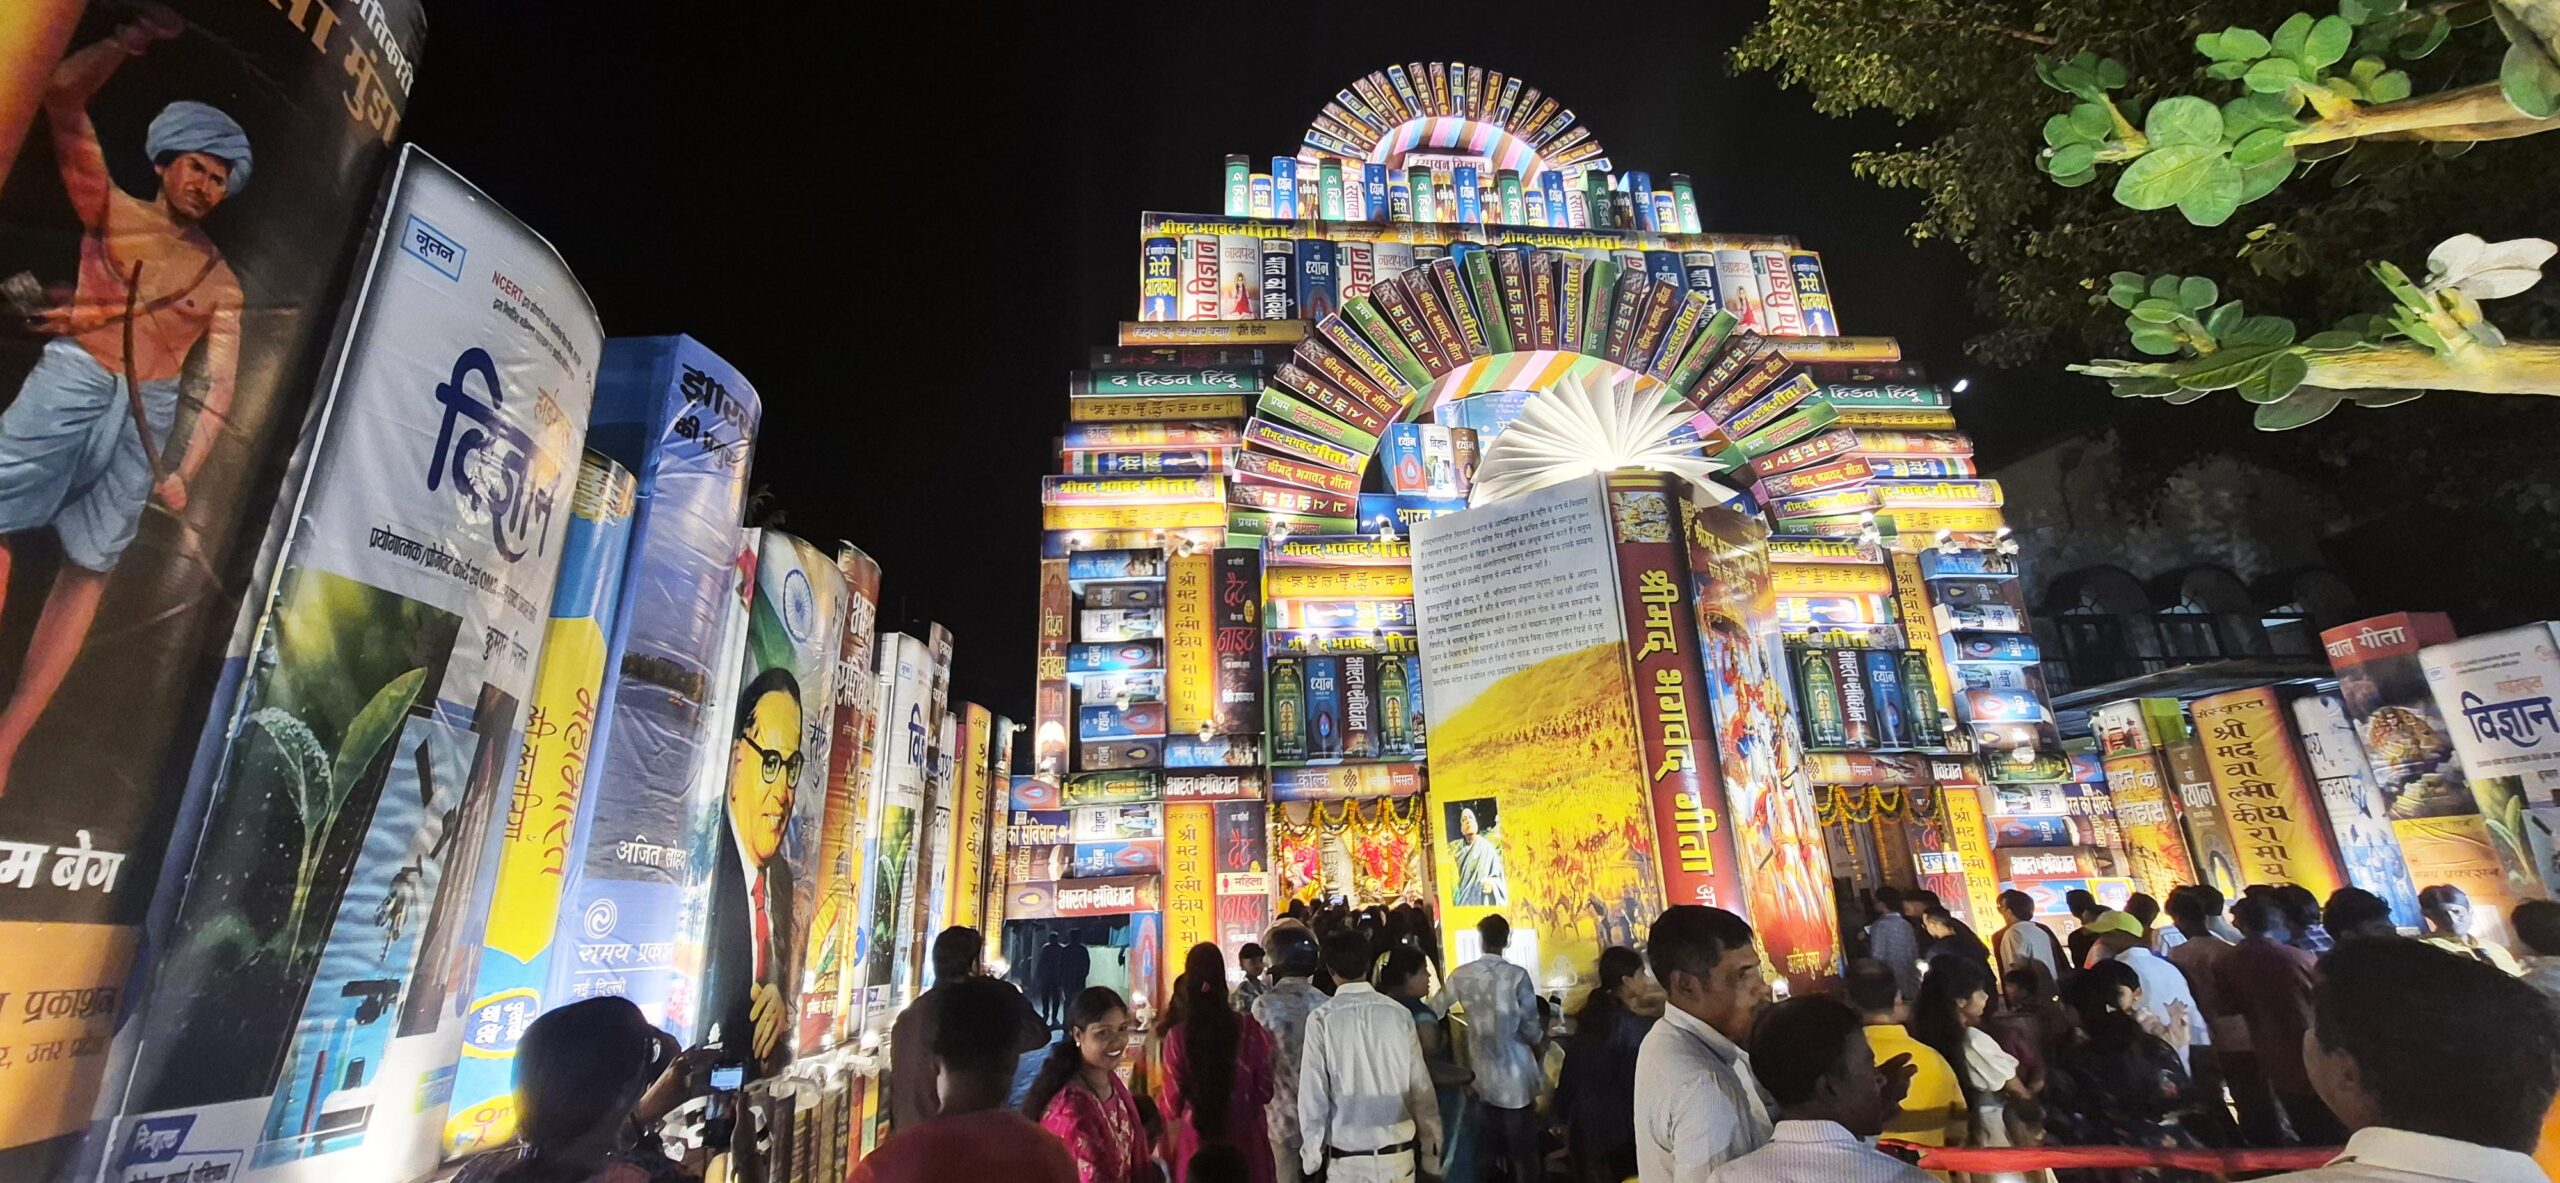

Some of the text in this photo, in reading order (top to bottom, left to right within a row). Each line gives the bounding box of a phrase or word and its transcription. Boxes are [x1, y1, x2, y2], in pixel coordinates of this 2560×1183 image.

[416, 228, 455, 263] नूतन
[1148, 255, 1172, 277] मेरी
[1304, 260, 1330, 276] ध्यान
[492, 270, 524, 303] NCERT
[1111, 374, 1129, 388] द
[1137, 371, 1195, 387] हिडन
[2357, 626, 2407, 650] गीता
[1310, 677, 1334, 691] ध्यान
[2196, 699, 2265, 719] संस्कृत
[2460, 690, 2560, 748] विज्ञान
[1167, 773, 1240, 797] भारत संविधान
[2179, 781, 2217, 809] ध्यान
[1674, 790, 1719, 876] गीता
[616, 834, 662, 867] अजित
[1234, 874, 1263, 887] महिला
[1058, 885, 1135, 911] भारत संविधान
[573, 977, 592, 999] नई
